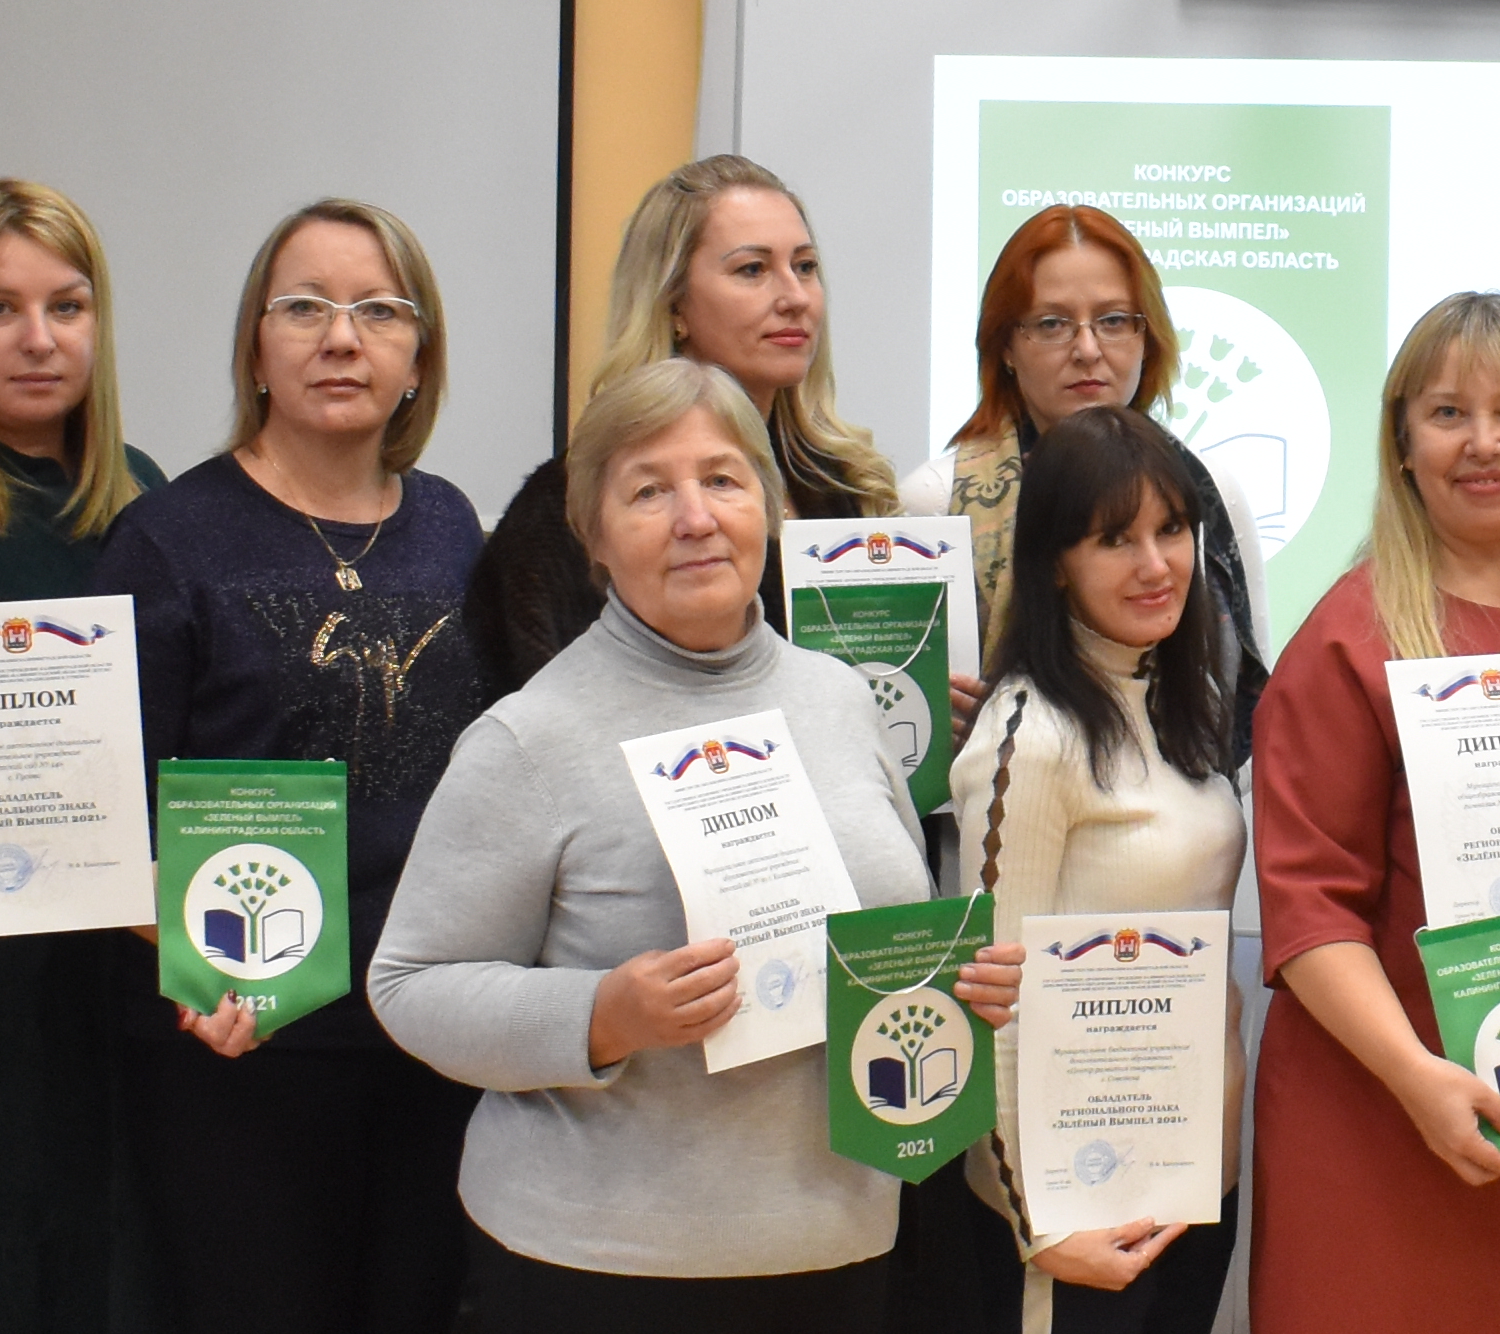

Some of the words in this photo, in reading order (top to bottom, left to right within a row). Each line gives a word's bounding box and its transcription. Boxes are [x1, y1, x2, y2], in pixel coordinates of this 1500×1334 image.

[1134, 164, 1231, 184] КОНКУРС
[1212, 191, 1366, 215] ОРГАНИЗАЦИЙ
[1188, 221, 1290, 241] ВЫМПЕЛ»
[1242, 252, 1339, 272] ОБЛАСТЬ
[230, 788, 276, 797] КОНКУРС
[701, 802, 779, 838] ДИПЛОМ
[1072, 997, 1172, 1019] ДИПЛОМ
